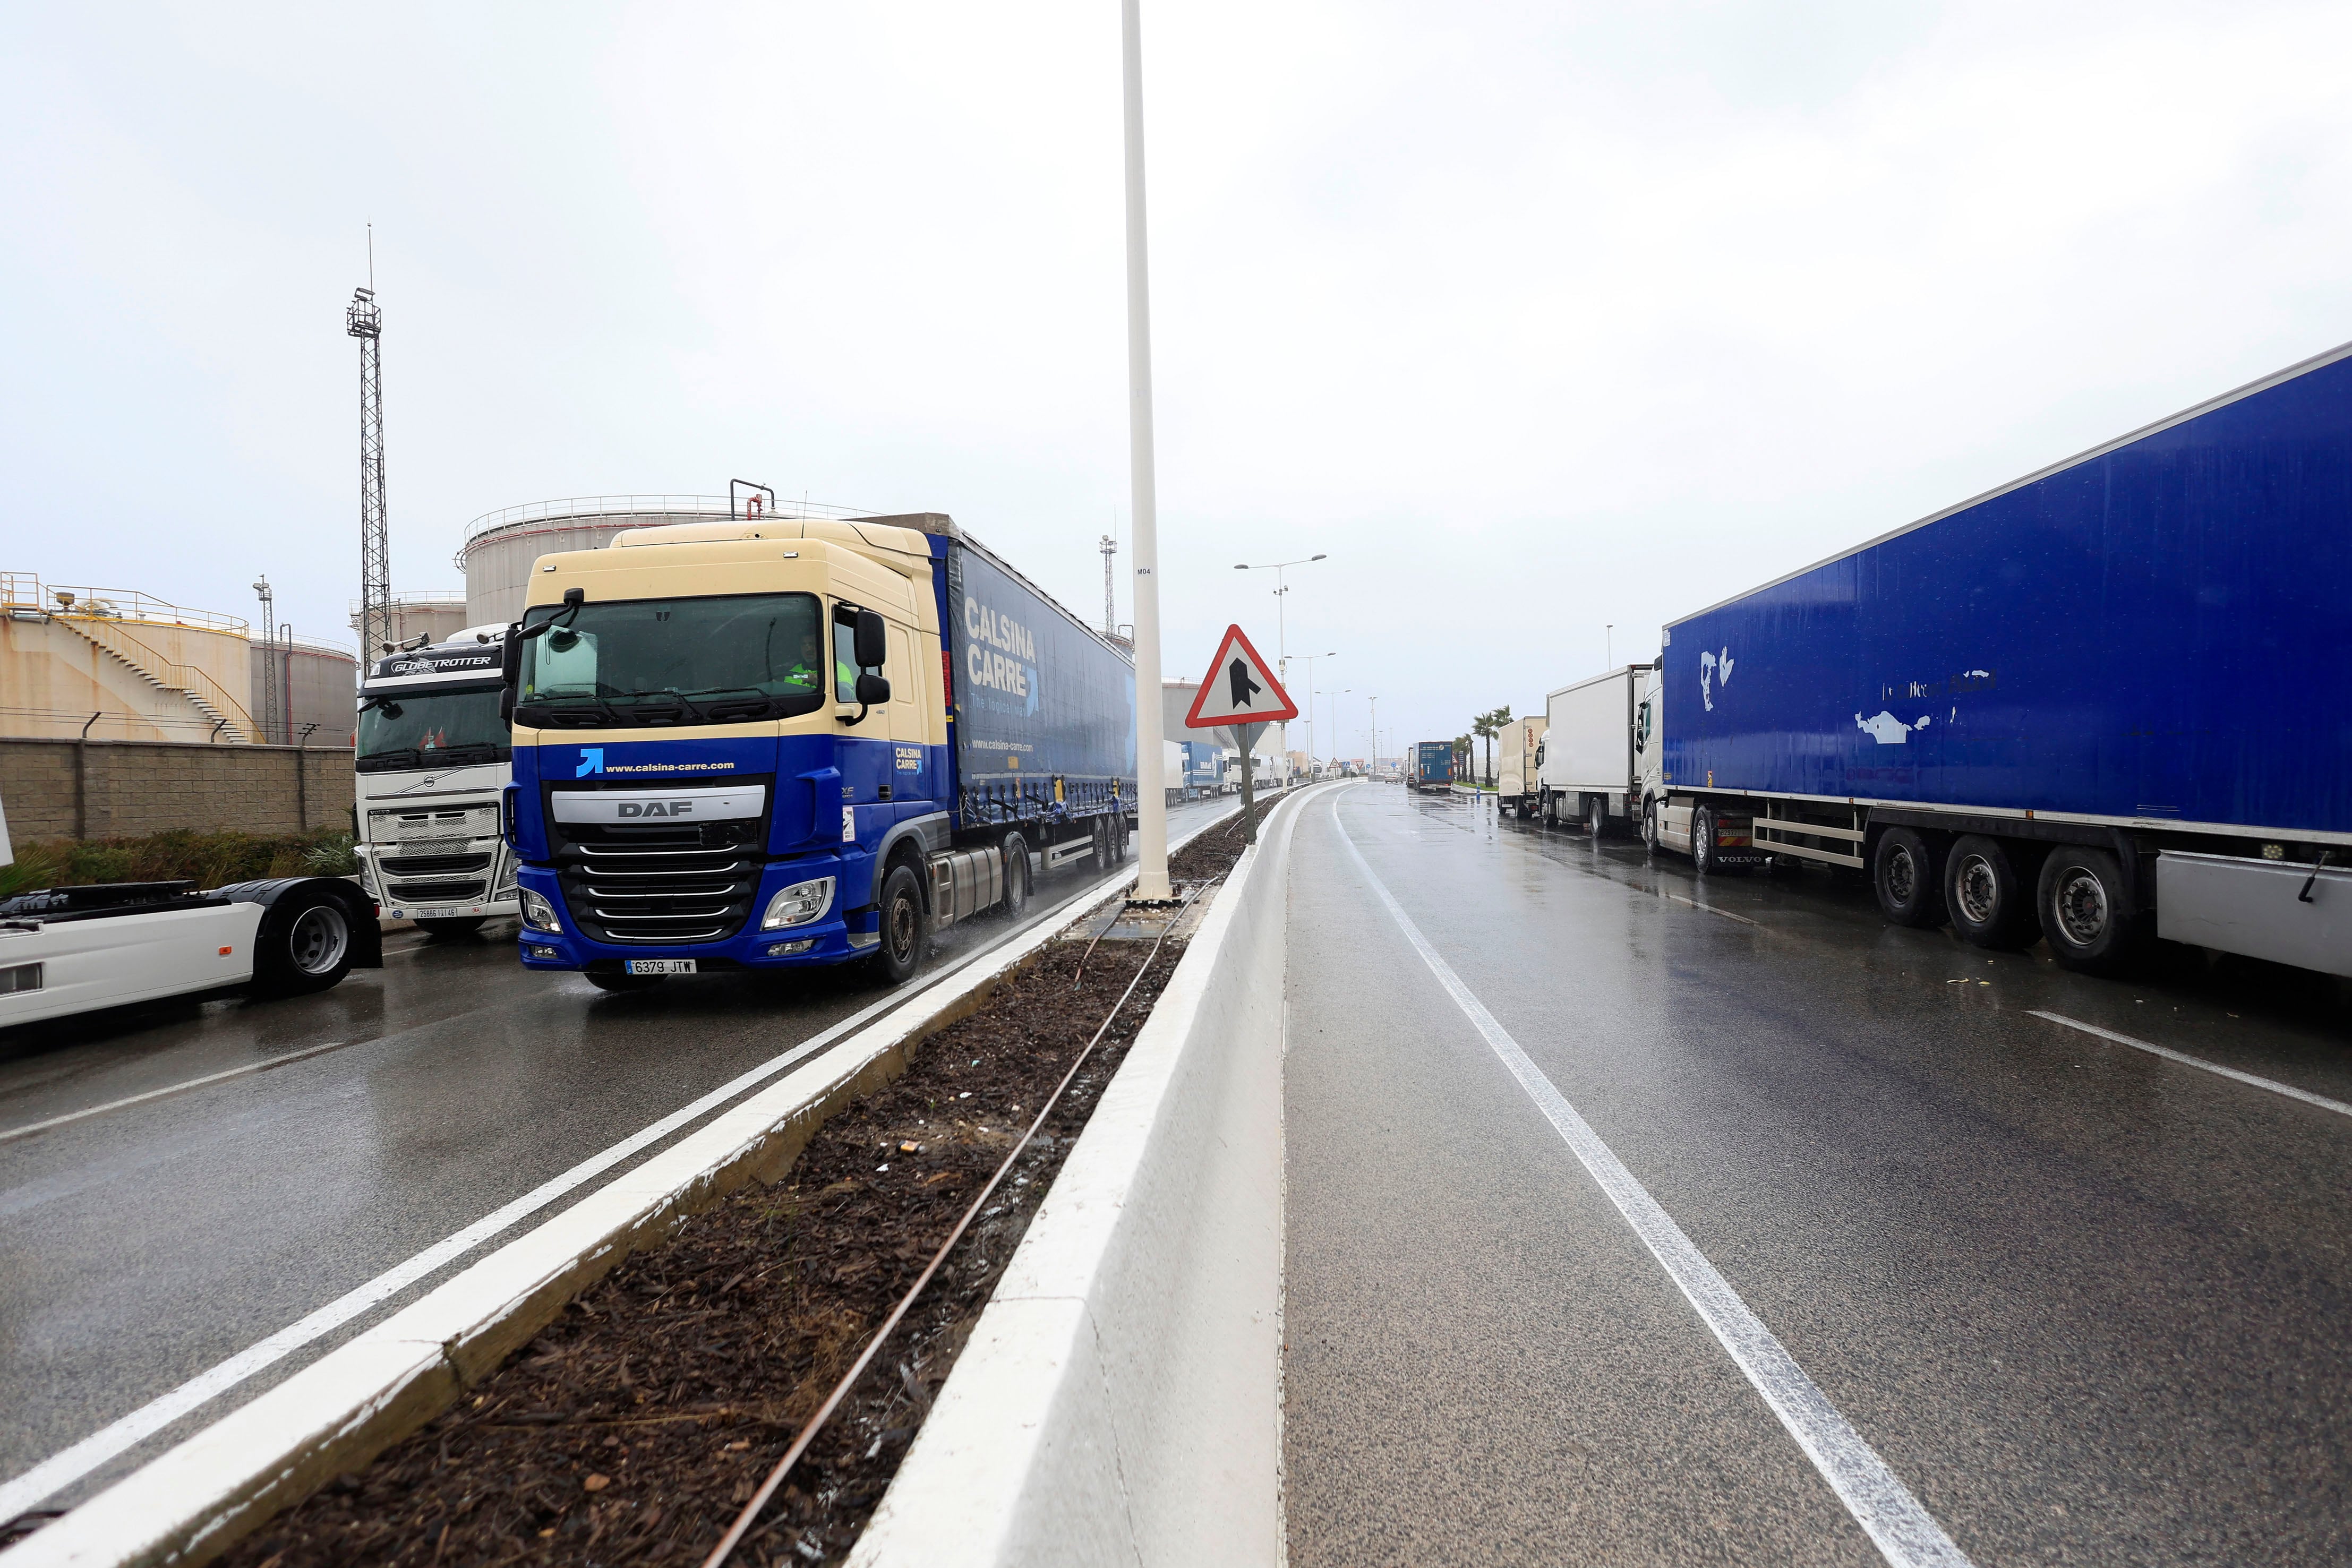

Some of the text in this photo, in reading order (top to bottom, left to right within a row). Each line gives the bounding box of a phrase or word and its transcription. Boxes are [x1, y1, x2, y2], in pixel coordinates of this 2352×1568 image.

[964, 596, 1036, 663] CALSINA
[394, 657, 491, 672] GLOBETROTTER
[968, 644, 1026, 697] CARRE
[971, 692, 985, 709] The
[988, 697, 1012, 715] logical
[972, 739, 1033, 752] www.calsina-carre.com
[895, 747, 921, 759] CALSINA
[606, 762, 734, 773] www.calsina-carre.com
[896, 759, 917, 769] CARRE
[618, 801, 692, 817] DAF
[635, 961, 664, 973] 6379
[671, 961, 691, 973] JTW
